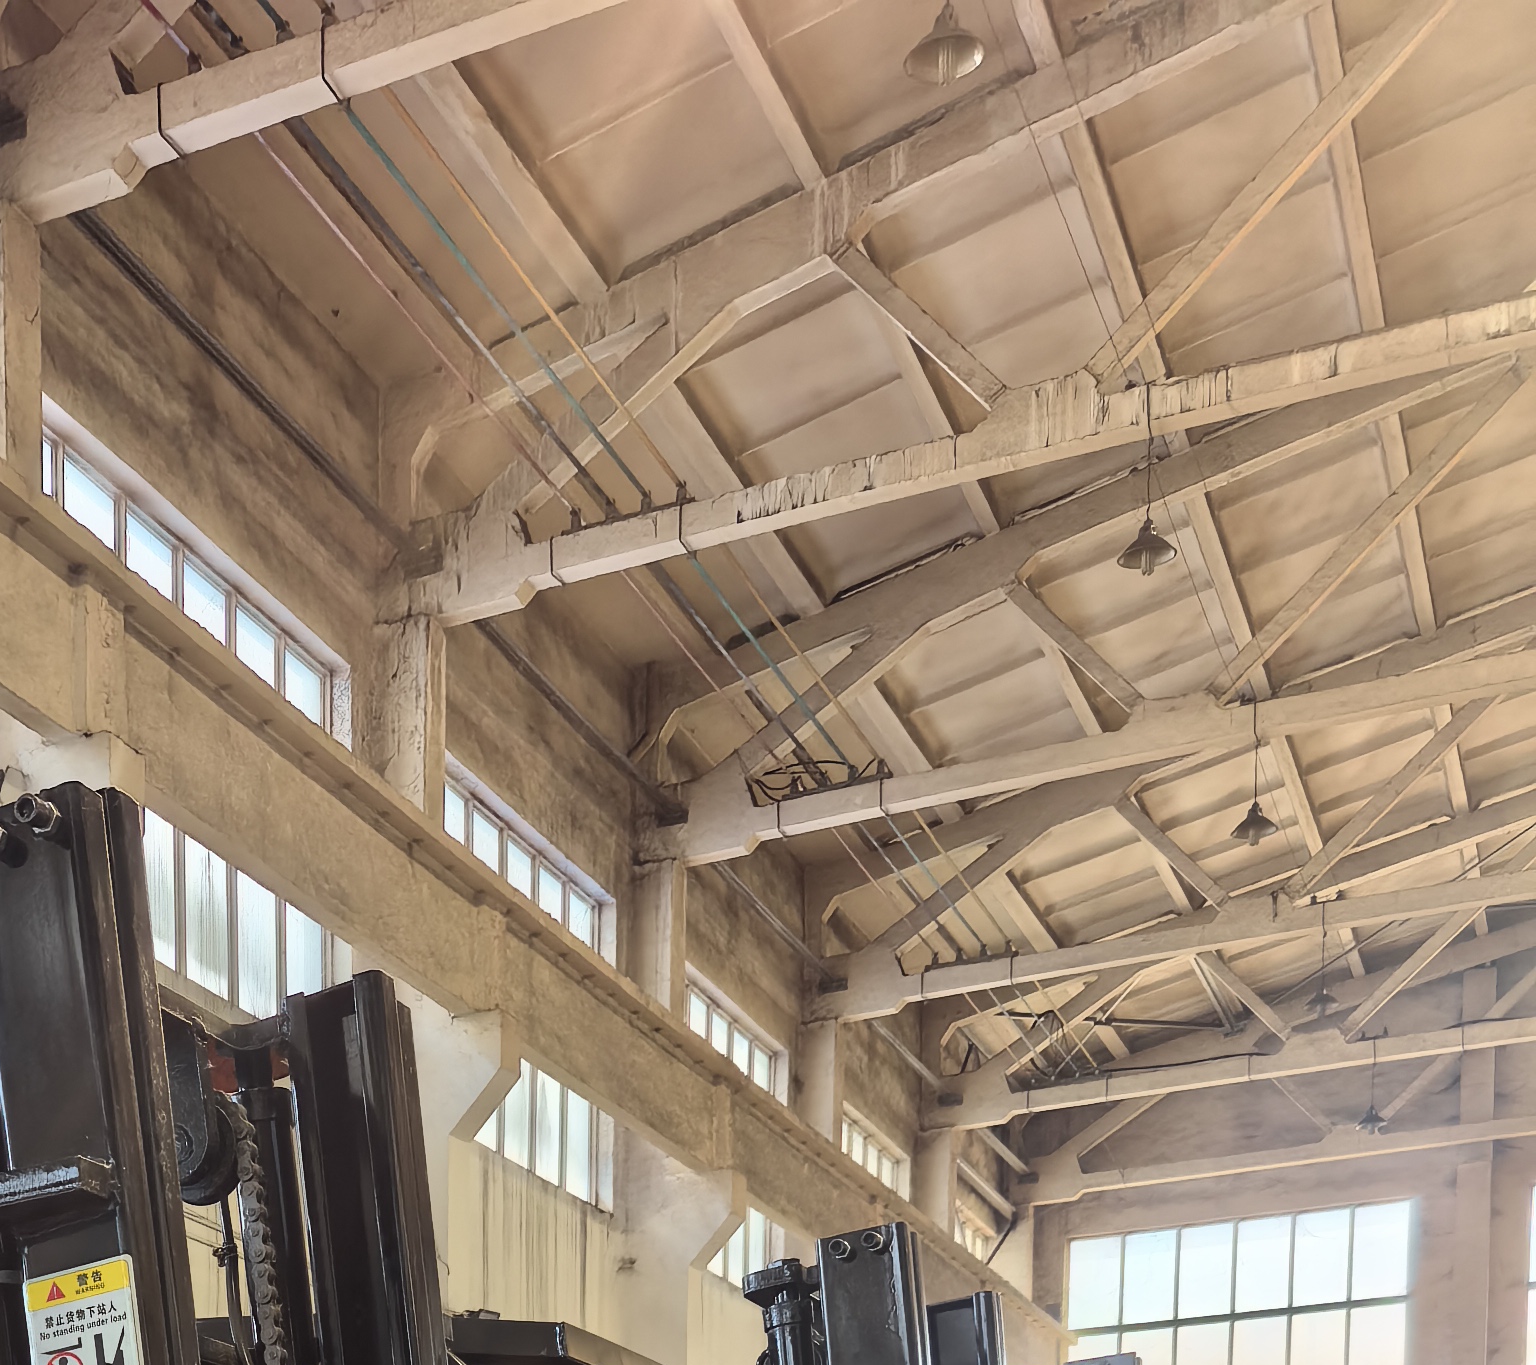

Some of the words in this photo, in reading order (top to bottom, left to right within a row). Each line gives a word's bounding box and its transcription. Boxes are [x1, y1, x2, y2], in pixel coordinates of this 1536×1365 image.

[77, 1269, 102, 1287] 警告
[39, 1332, 50, 1341] No
[53, 1325, 84, 1338] standing
[87, 1318, 108, 1329] under
[110, 1311, 127, 1323] load
[45, 1300, 117, 1329] 禁止货物下站人
